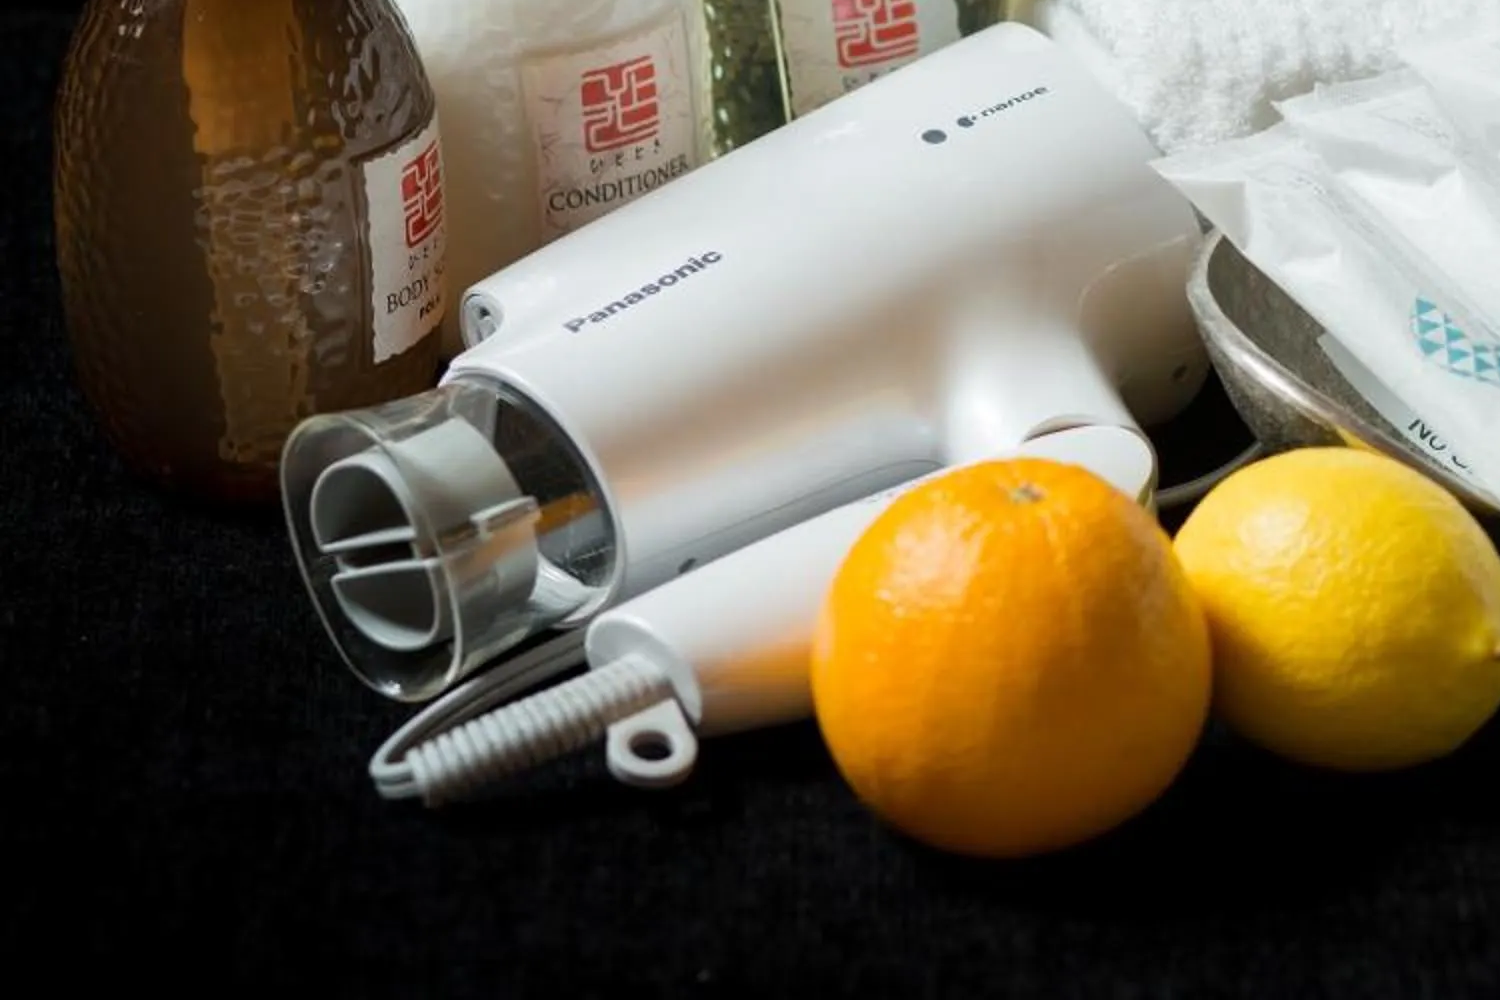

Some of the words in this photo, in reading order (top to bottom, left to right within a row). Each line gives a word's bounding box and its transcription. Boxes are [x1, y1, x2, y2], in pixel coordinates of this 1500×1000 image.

[980, 86, 1048, 117] nanoe
[549, 153, 690, 212] CONDITIONER
[386, 271, 430, 314] BODY
[563, 250, 722, 333] Panasonic
